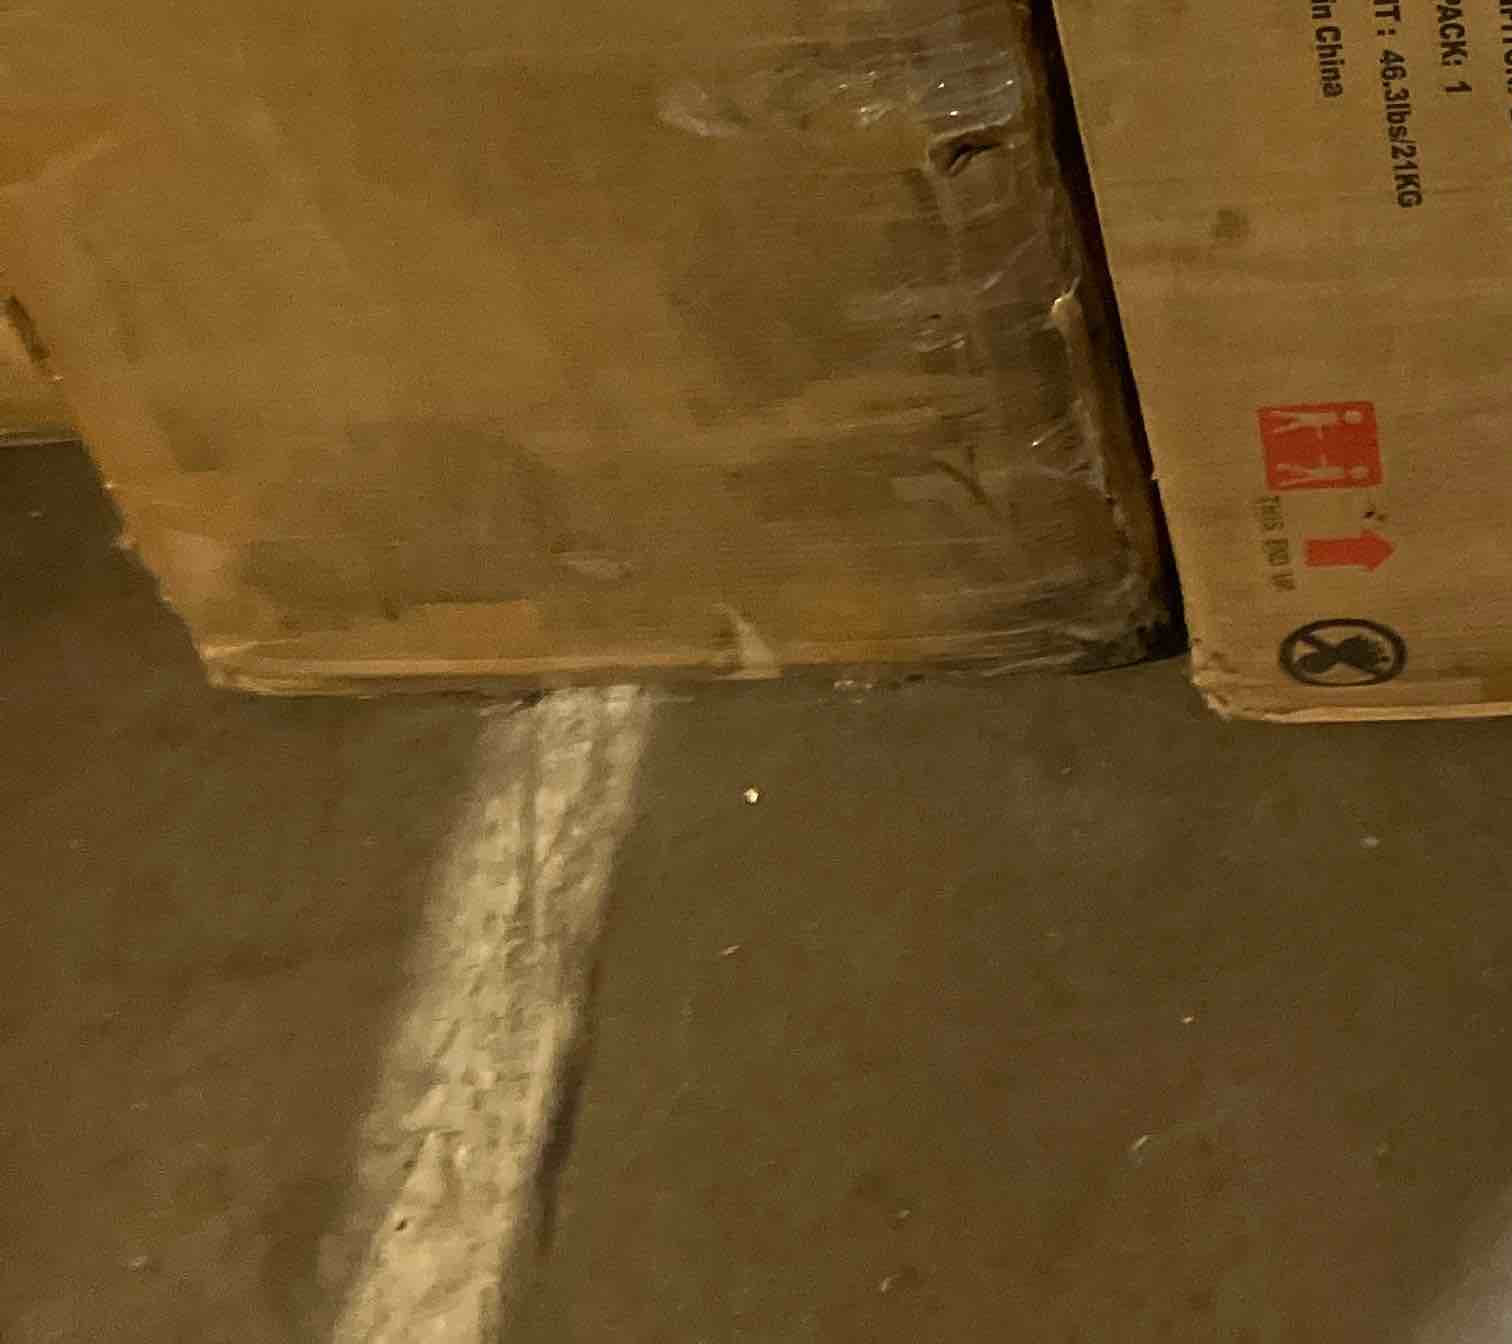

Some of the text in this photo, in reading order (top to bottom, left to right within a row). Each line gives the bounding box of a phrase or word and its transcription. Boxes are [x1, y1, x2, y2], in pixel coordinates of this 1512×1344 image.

[1315, 23, 1344, 98] China
[1444, 80, 1473, 95] 1
[1378, 48, 1423, 208] 46.3lbs/21KG
